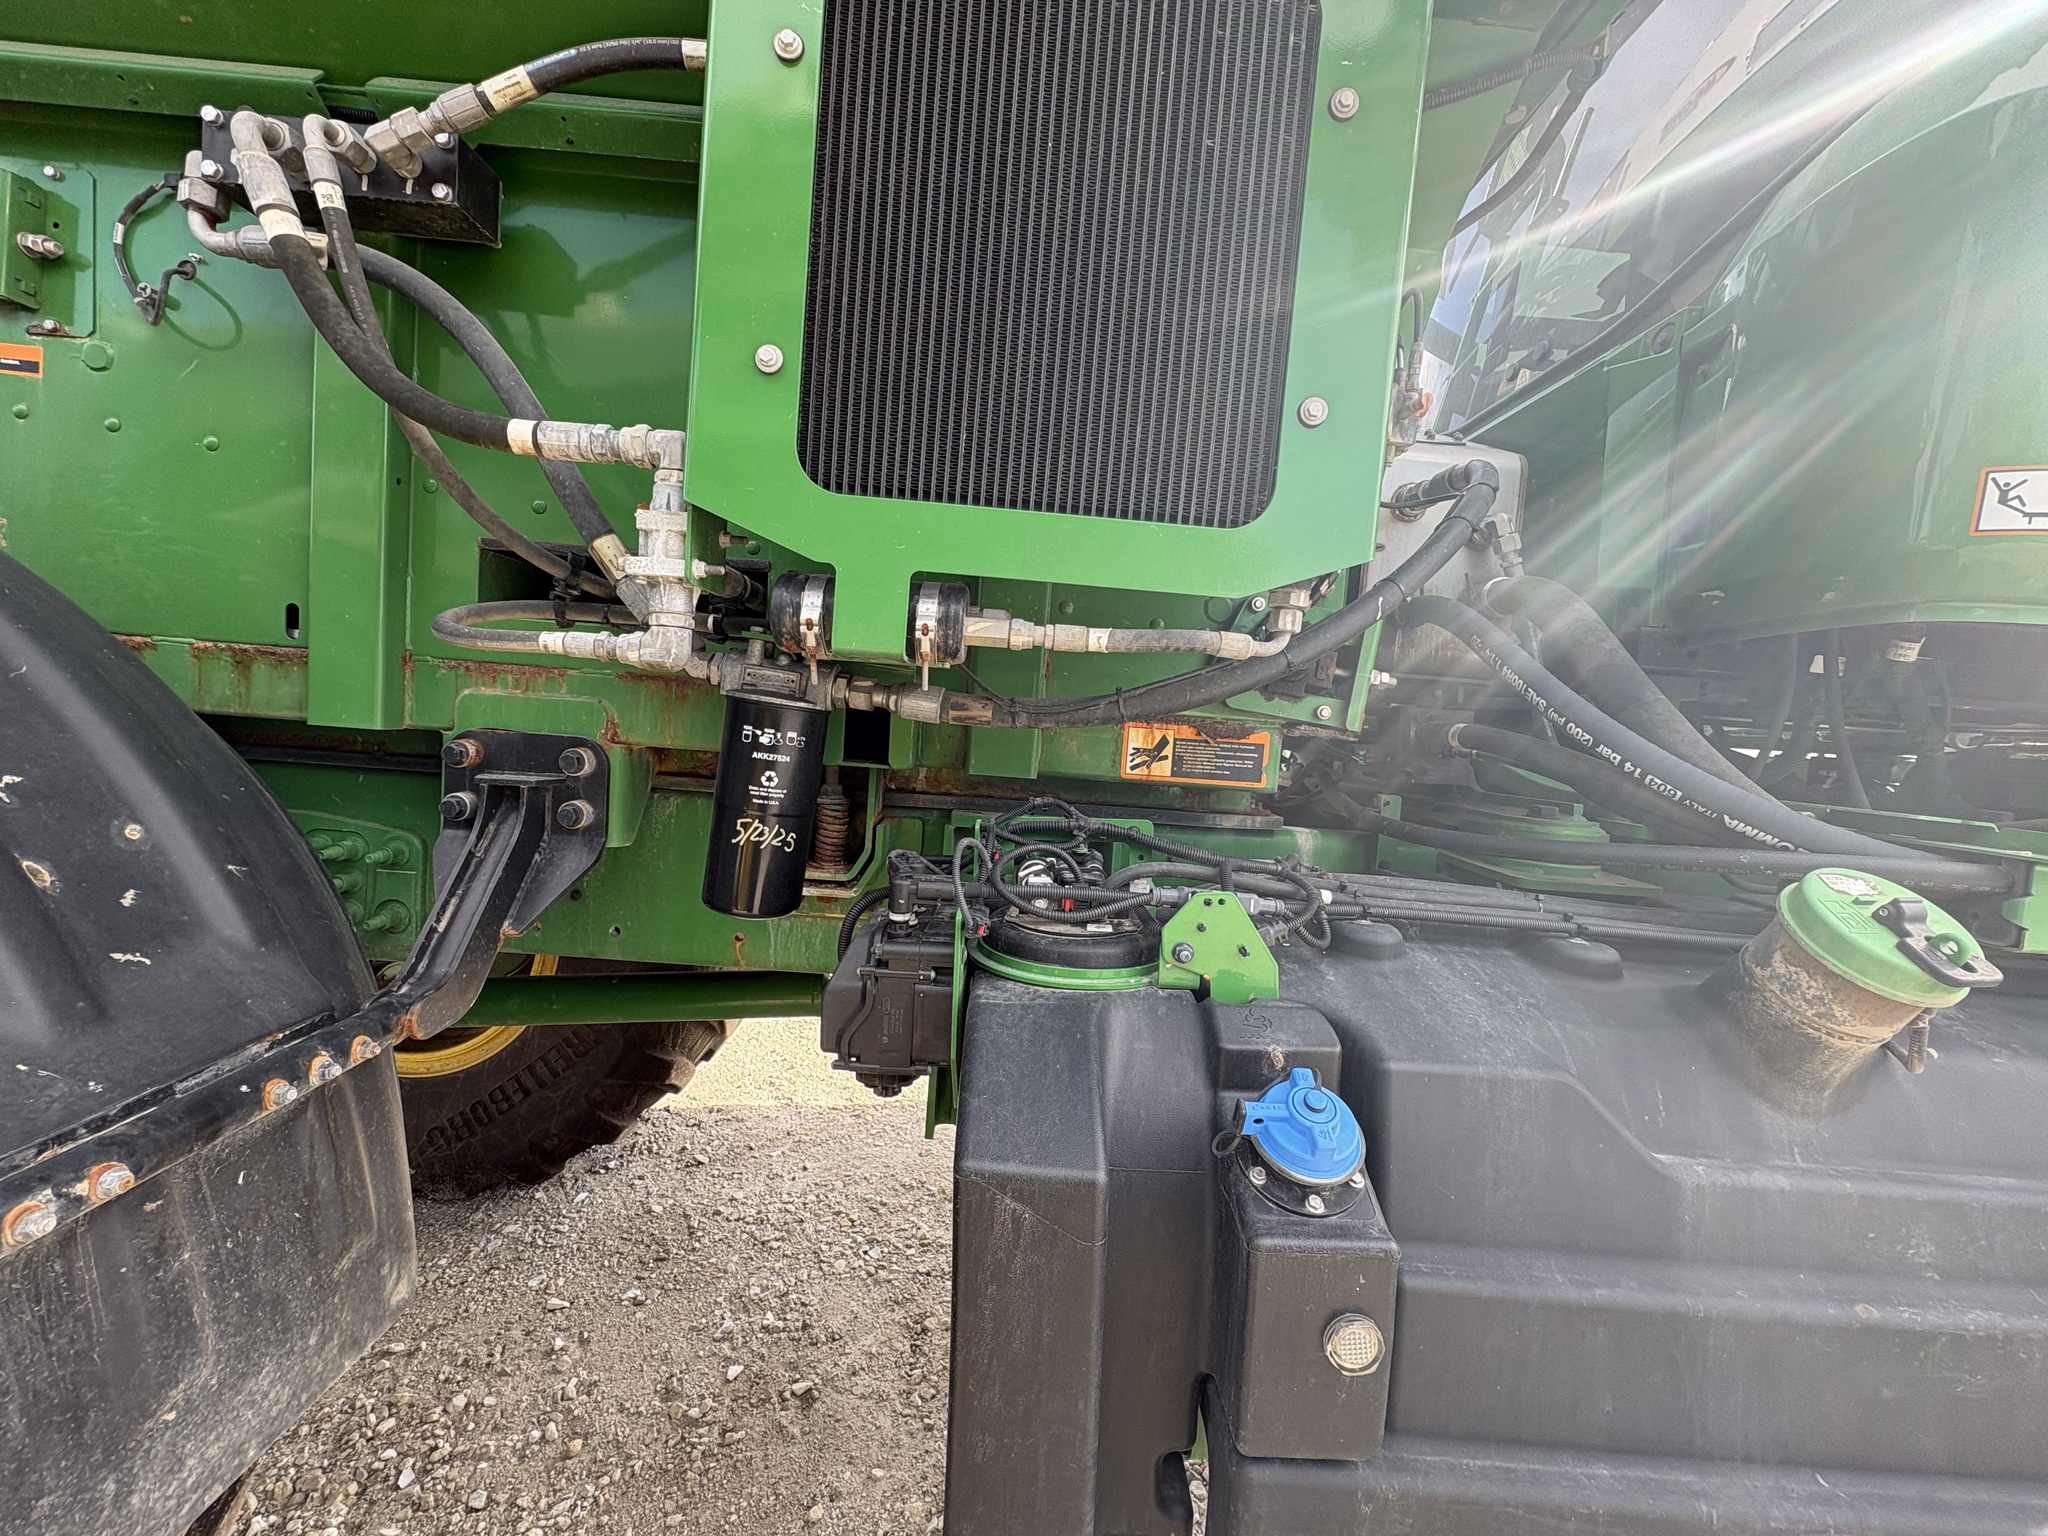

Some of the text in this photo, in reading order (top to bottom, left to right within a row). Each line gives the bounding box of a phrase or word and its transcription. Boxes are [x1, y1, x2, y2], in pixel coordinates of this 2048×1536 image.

[1502, 665, 1546, 712] SAE100R4
[1548, 708, 1566, 726] psi)
[1566, 722, 1593, 748] (200
[752, 752, 790, 762] AKK27524
[1595, 744, 1622, 766] bar
[1623, 762, 1641, 779] 14
[1647, 776, 1679, 800] 604
[1682, 800, 1717, 818] ITALY
[732, 818, 796, 852] 5/23/25
